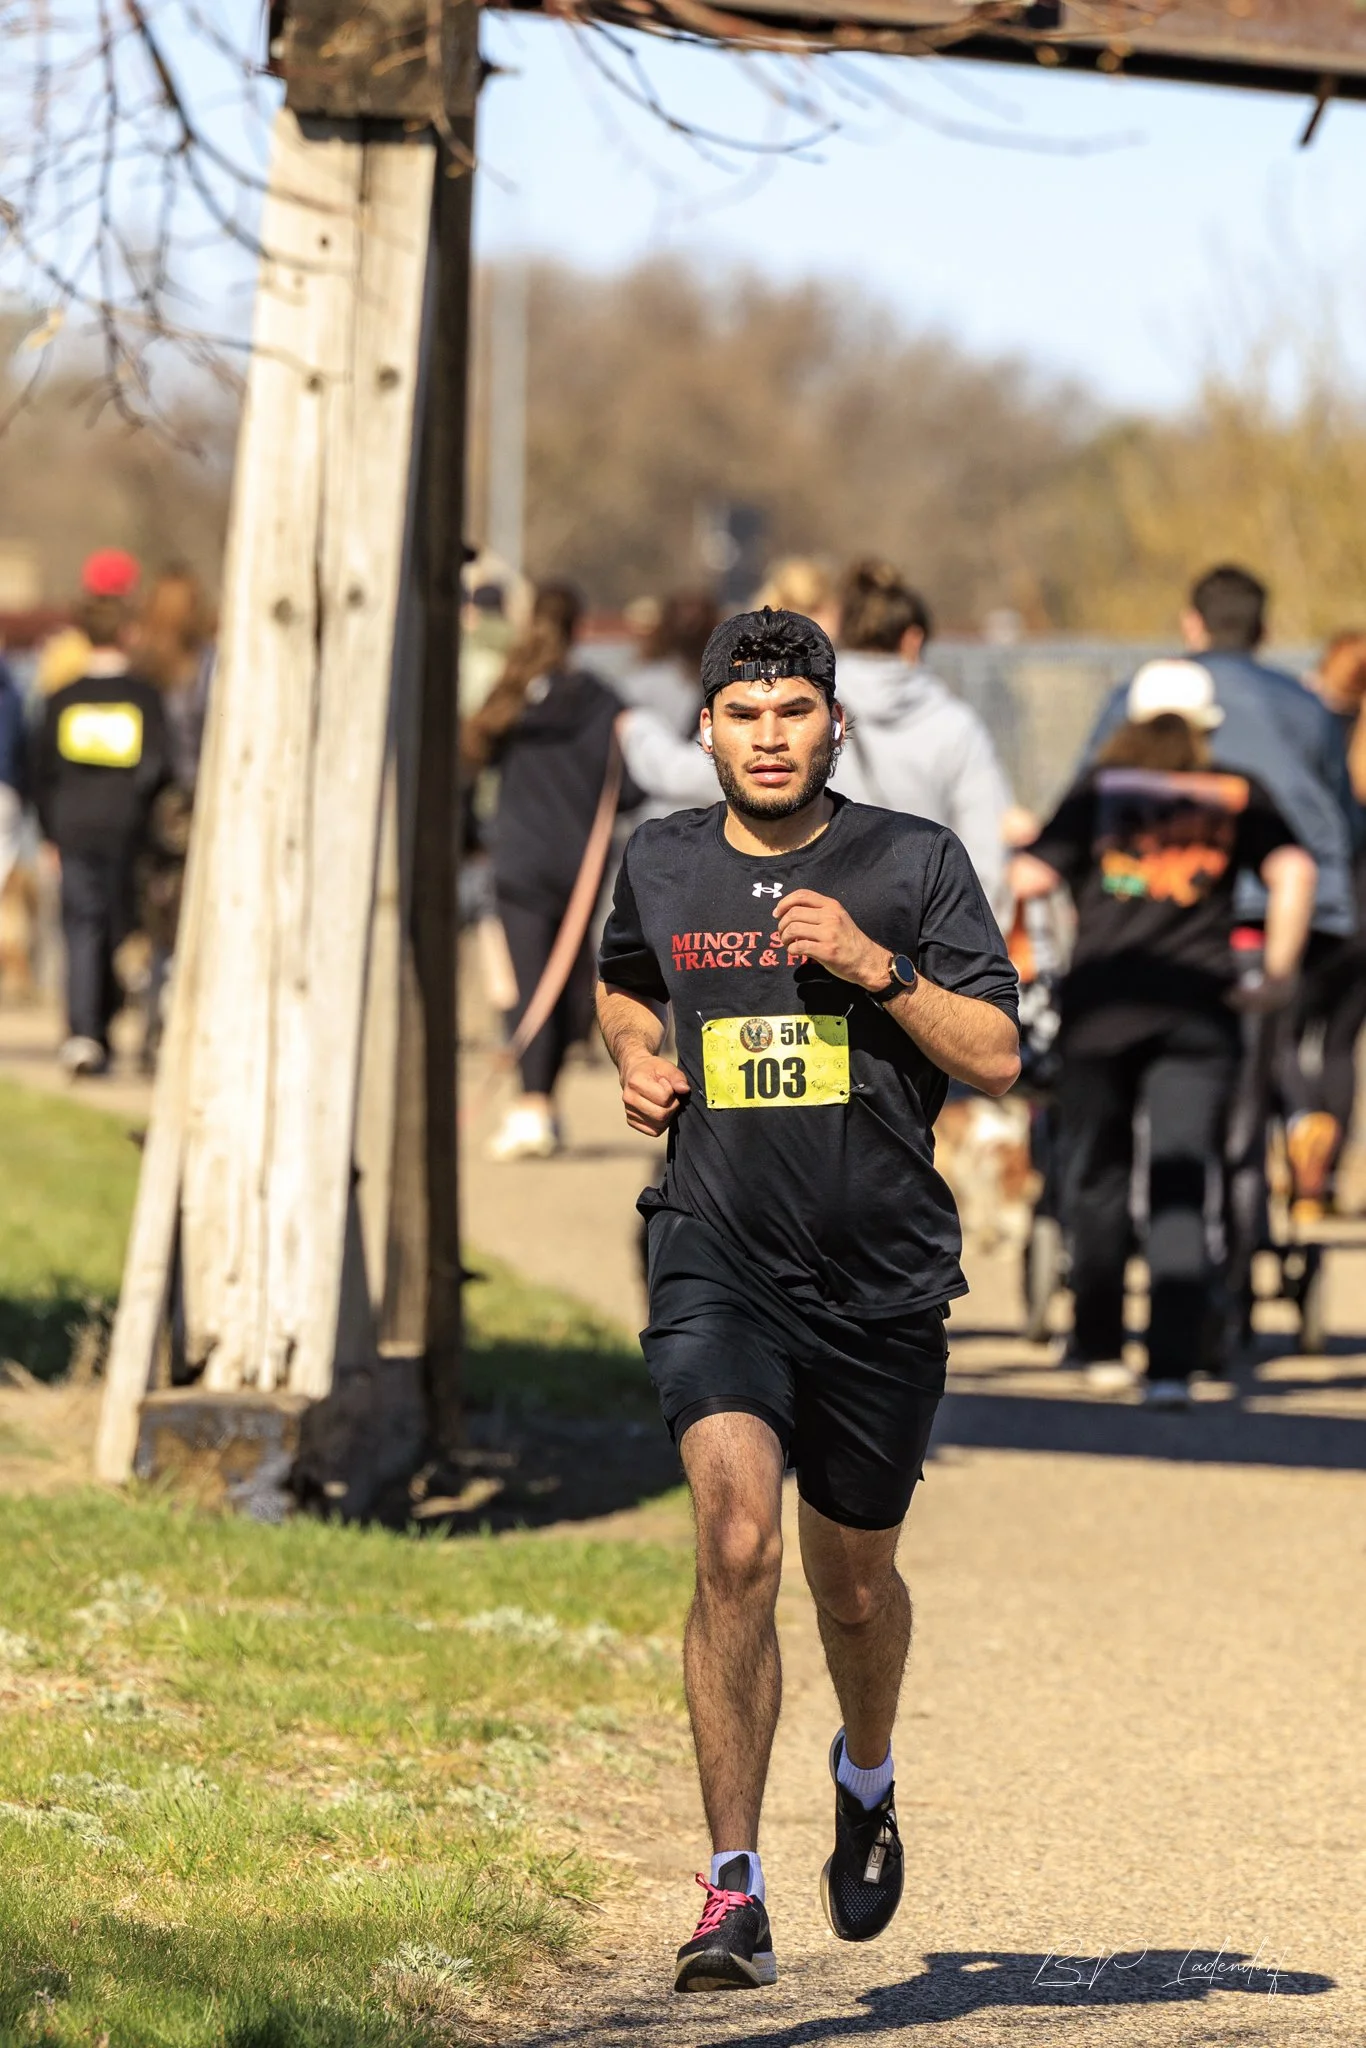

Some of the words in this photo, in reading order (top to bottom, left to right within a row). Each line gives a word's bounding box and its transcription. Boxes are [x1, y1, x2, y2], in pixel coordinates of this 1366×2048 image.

[671, 932, 762, 952] MINOT
[769, 931, 784, 948] S
[672, 951, 752, 970] TRACK
[758, 949, 779, 967] &
[780, 1022, 810, 1046] 5K
[738, 1057, 807, 1099] 103
